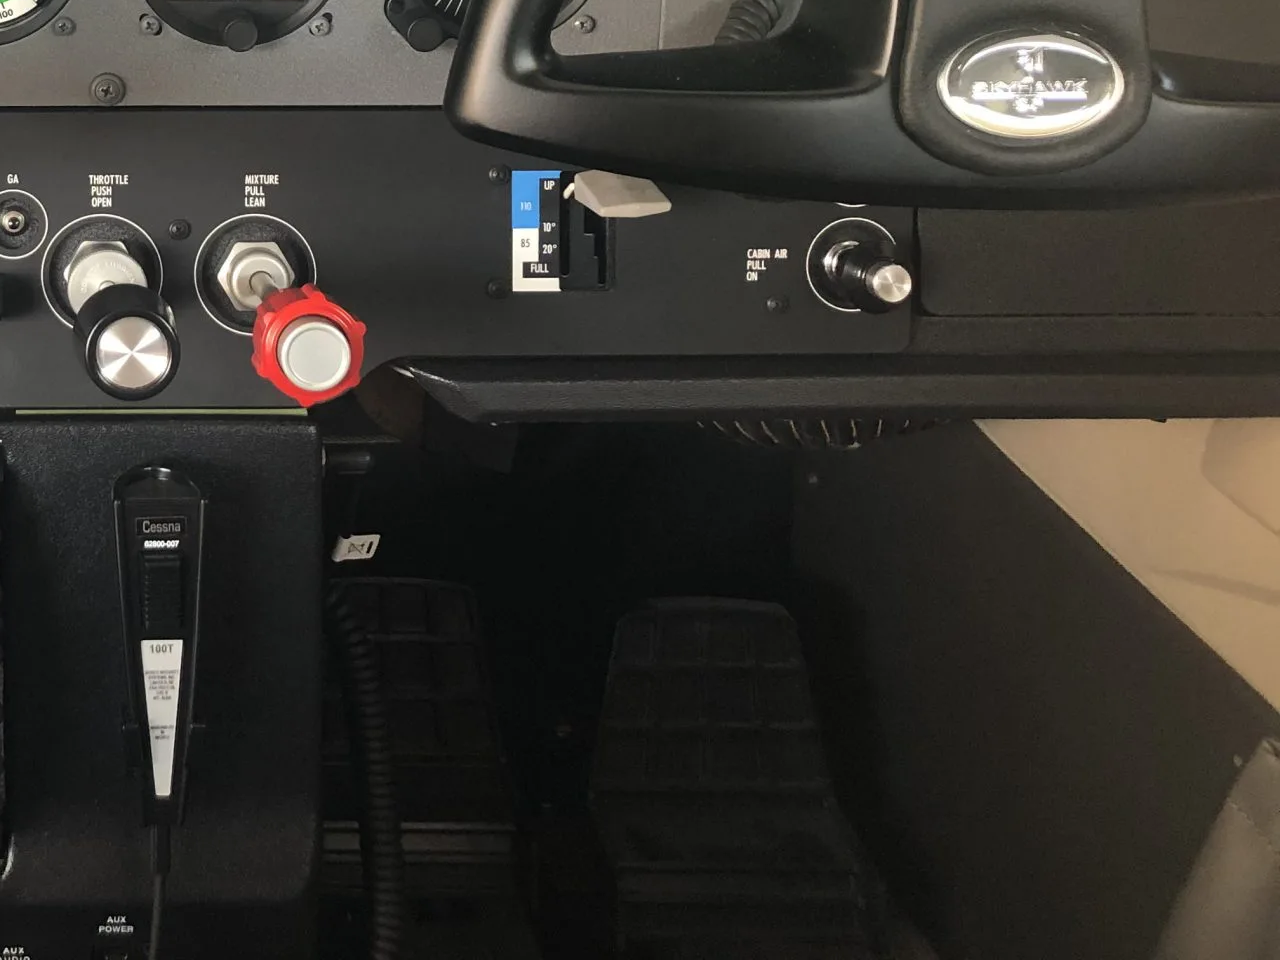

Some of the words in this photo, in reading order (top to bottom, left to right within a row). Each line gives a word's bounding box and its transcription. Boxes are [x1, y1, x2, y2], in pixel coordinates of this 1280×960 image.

[7, 174, 19, 184] GA
[89, 175, 128, 184] THROTTLE
[245, 175, 279, 184] MIXTURE
[544, 181, 555, 190] UP
[91, 186, 112, 196] PUSH
[245, 186, 264, 196] PULL
[92, 197, 112, 207] OPEN
[245, 197, 265, 207] LEAN
[747, 249, 770, 258] CABIN
[775, 249, 787, 258] AIR
[531, 263, 549, 273] FULL
[747, 260, 766, 270] PULL
[747, 272, 757, 280] ON
[143, 520, 180, 533] Cessna
[150, 644, 173, 653] 100T
